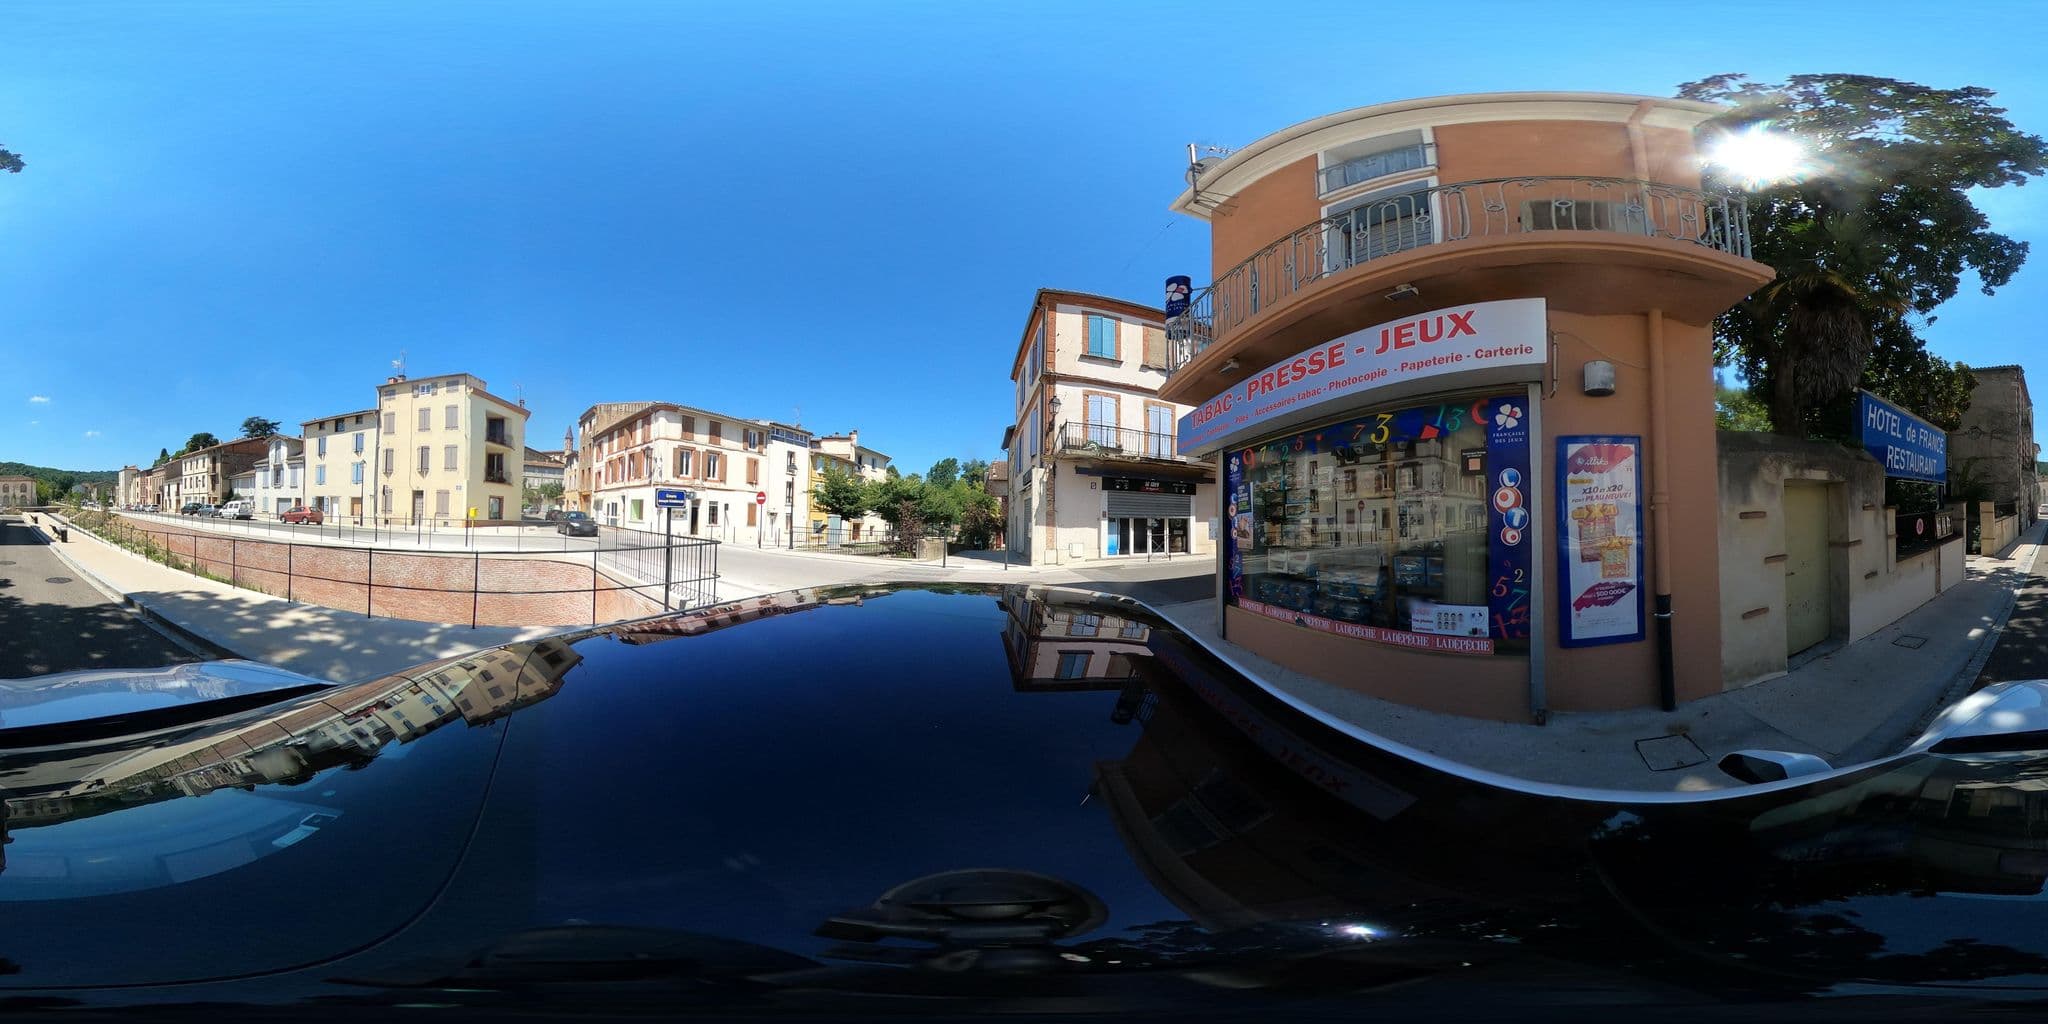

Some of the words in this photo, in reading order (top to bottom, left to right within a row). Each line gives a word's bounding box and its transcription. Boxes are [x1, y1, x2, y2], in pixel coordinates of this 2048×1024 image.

[1191, 393, 1233, 429] TABAC
[1247, 342, 1346, 401] PRESSE
[1375, 310, 1477, 355] JEUX
[1329, 367, 1388, 391] Photocopie
[1401, 352, 1463, 373] Papeterie
[1475, 344, 1533, 359] Carterie
[1370, 413, 1393, 444] 3
[1867, 403, 1902, 438] HOTEL
[1906, 423, 1916, 443] de
[1919, 428, 1944, 454] FRANCE
[1886, 445, 1937, 476] RESTAURANT
[1492, 576, 1510, 597] 5
[1514, 568, 1524, 583] 2
